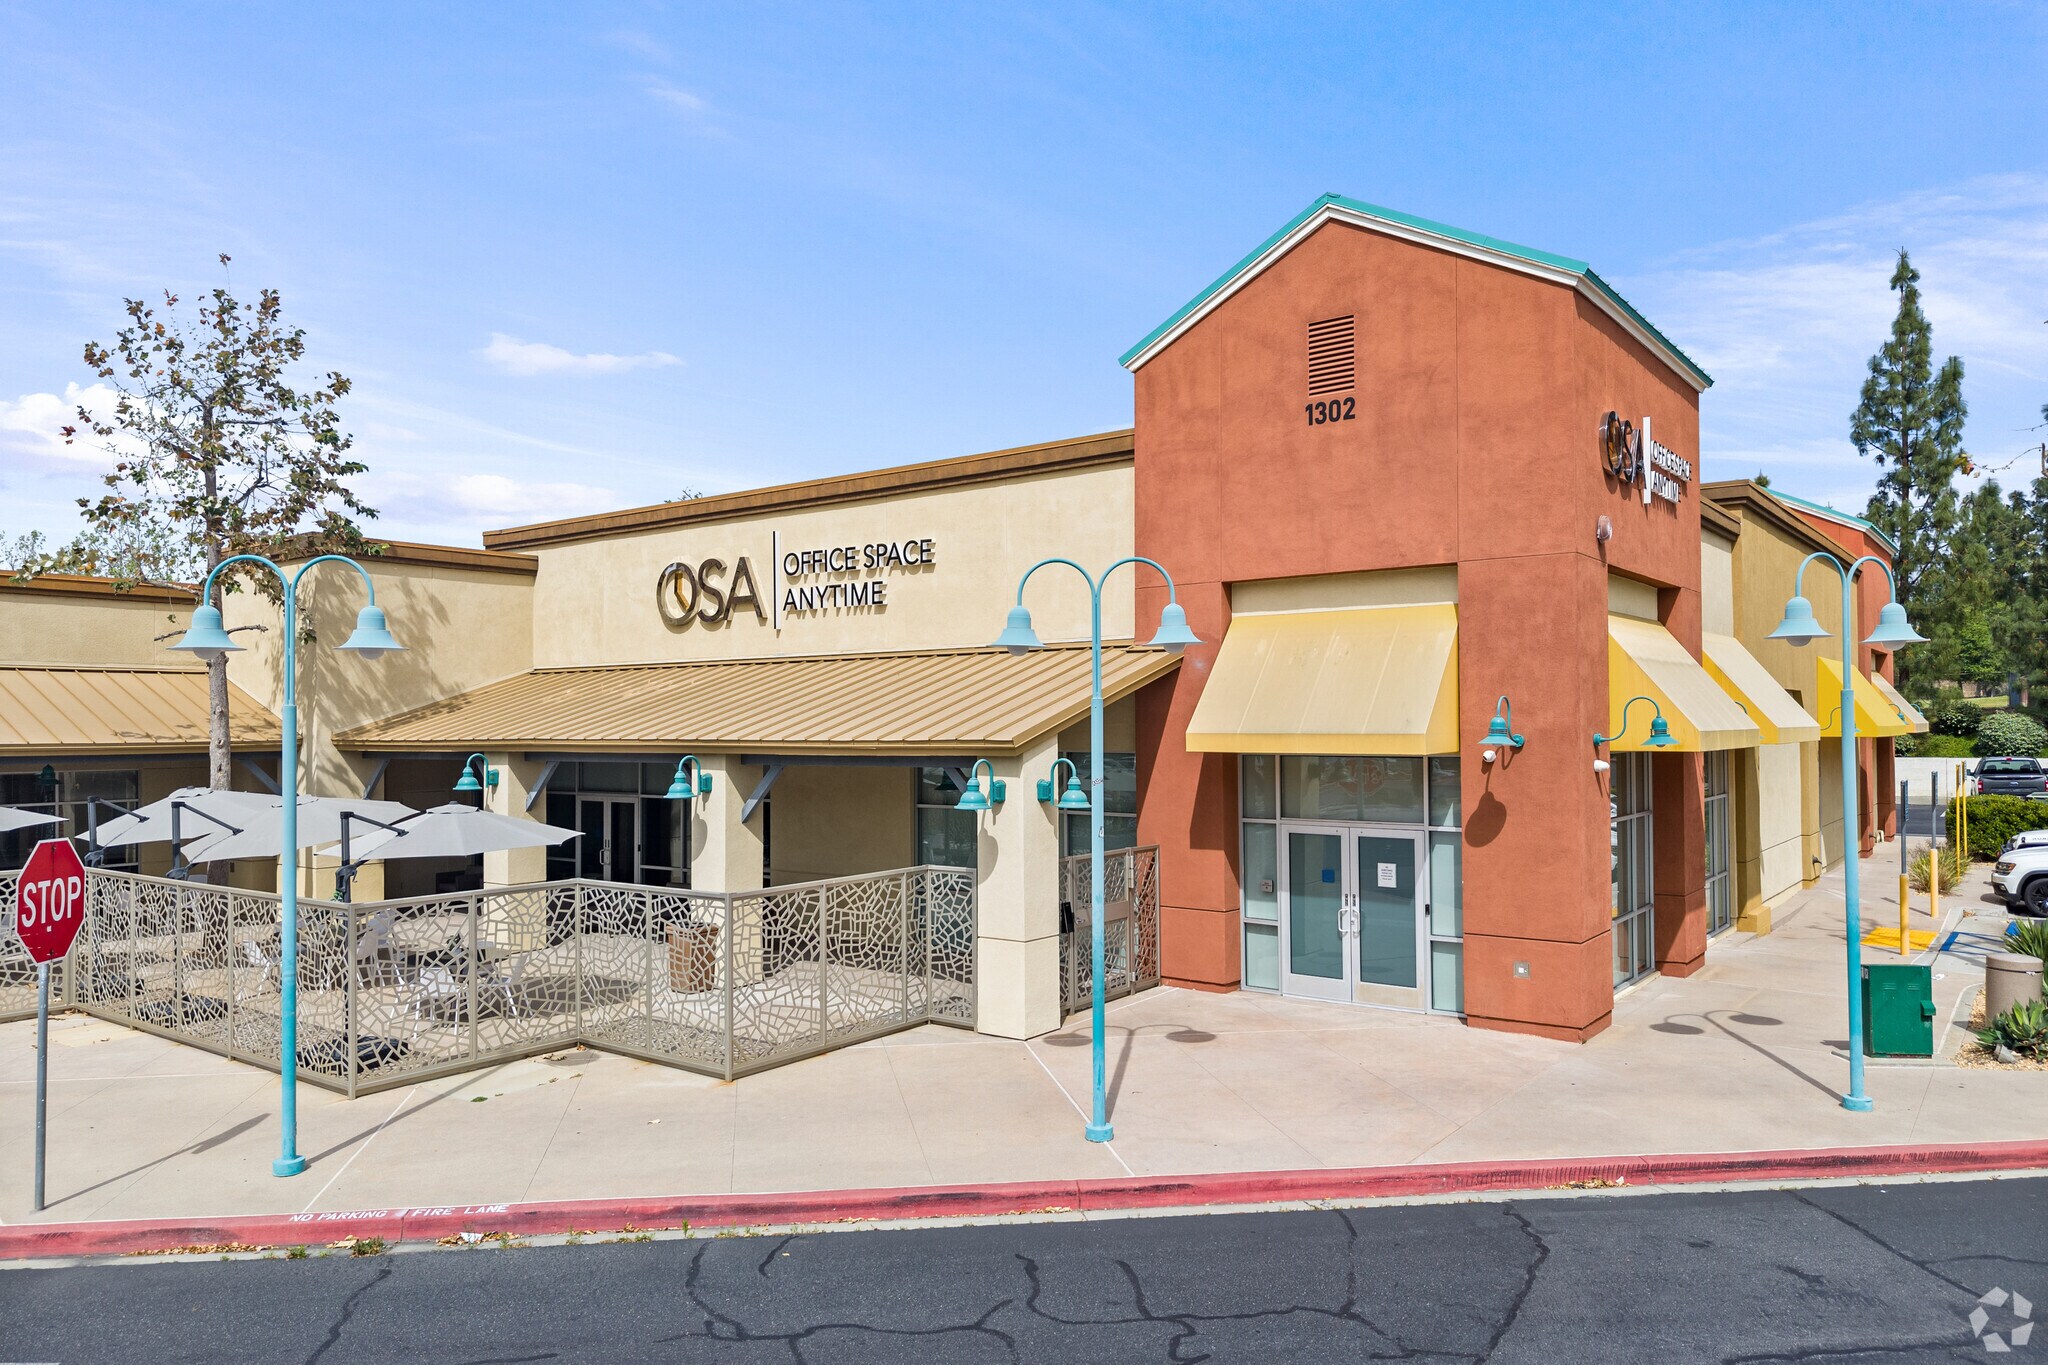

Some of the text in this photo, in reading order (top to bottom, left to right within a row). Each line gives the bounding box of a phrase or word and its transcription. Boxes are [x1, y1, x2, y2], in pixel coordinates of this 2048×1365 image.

[1305, 397, 1356, 426] 1302
[783, 539, 935, 577] OFFICE SPACE
[656, 557, 767, 626] OSA
[783, 581, 886, 612] ANYTIME
[21, 876, 81, 927] STOP
[289, 1204, 509, 1222] NO PARKING FIRE LANE
